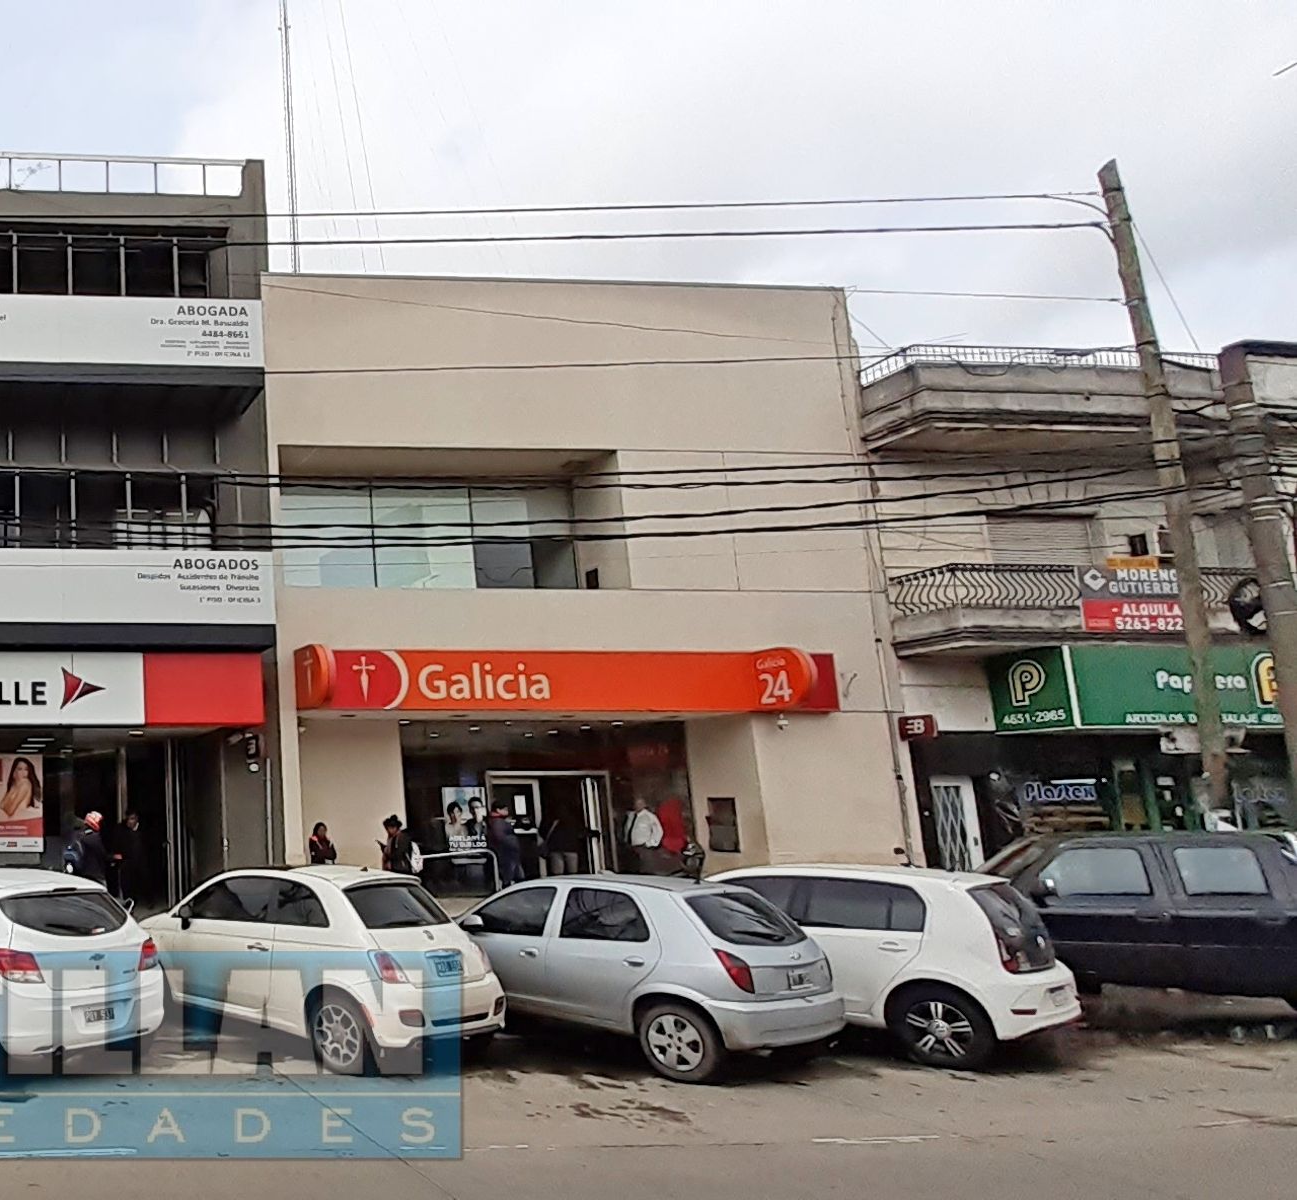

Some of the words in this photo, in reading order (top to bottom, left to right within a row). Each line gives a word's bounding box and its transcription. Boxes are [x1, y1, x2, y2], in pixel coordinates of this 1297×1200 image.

[177, 305, 249, 317] ABOGADA
[172, 558, 259, 570] ABOGADOS
[1109, 582, 1180, 594] GUTIERRE
[1122, 603, 1182, 616] ALQUILA
[1115, 617, 1184, 631] 5263-822
[755, 656, 786, 669] Galicia
[418, 662, 551, 700] Galicia
[758, 670, 793, 704] 24
